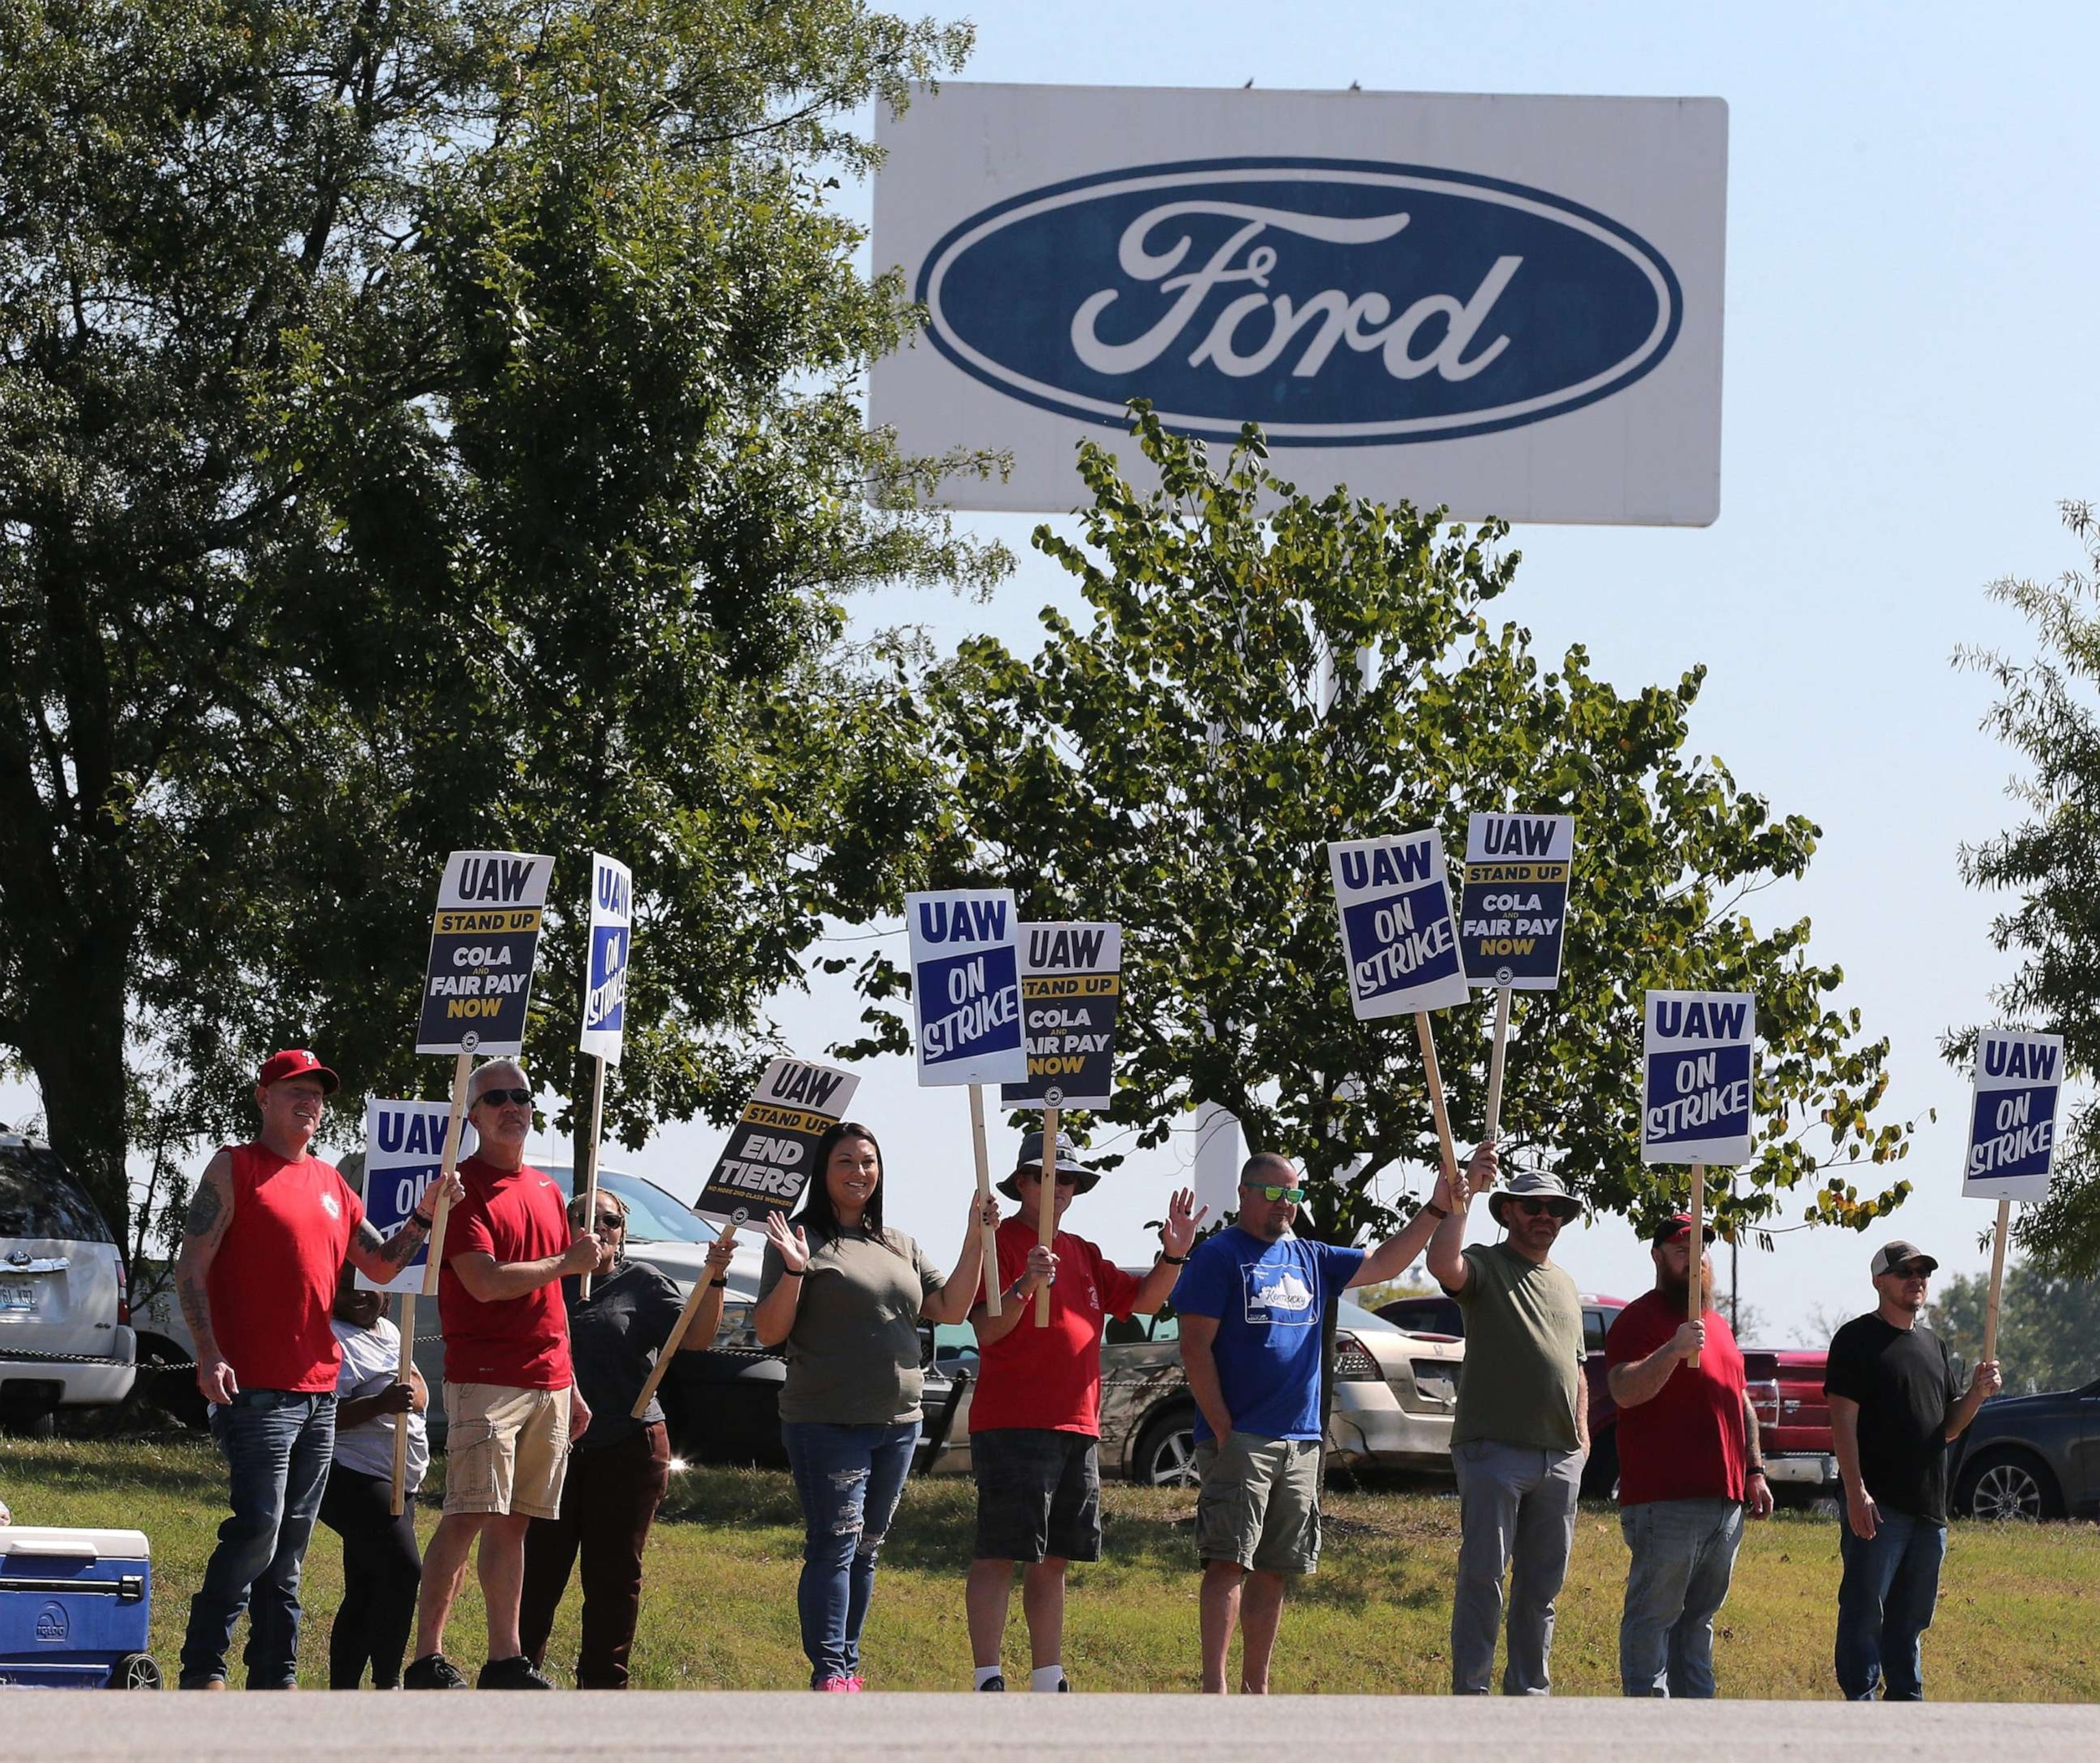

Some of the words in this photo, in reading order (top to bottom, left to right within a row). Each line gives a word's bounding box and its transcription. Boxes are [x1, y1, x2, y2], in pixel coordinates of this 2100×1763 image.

[1071, 200, 1524, 383] Ford
[1484, 819, 1557, 856] UAW
[459, 859, 535, 901] UAW
[1340, 840, 1431, 889] UAW
[1470, 868, 1531, 881] STAND
[1537, 867, 1562, 880] UP
[598, 865, 629, 920] UAW
[1483, 894, 1542, 911] COLA
[441, 915, 505, 930] STAND
[509, 914, 535, 928] UP
[919, 900, 1007, 943] UAW
[1375, 897, 1414, 943] ON
[1463, 919, 1511, 937] FAIR
[1515, 919, 1559, 936] PAY
[453, 945, 512, 967] COLA
[604, 931, 621, 976] ON
[1029, 930, 1105, 969] UAW
[1355, 917, 1453, 996] STRIKE
[1481, 939, 1535, 956] NOW
[430, 975, 481, 996] FAIR
[484, 973, 527, 995] PAY
[588, 967, 625, 1027] STRIKE
[948, 956, 984, 1005] ON
[1086, 979, 1112, 993] UP
[446, 997, 502, 1019] NOW
[924, 984, 1019, 1061] STRIKE
[1028, 1008, 1092, 1029] COLA
[1656, 1001, 1747, 1040] UAW
[1025, 1036, 1060, 1055] AIR
[1064, 1034, 1111, 1053] PAY
[1984, 1040, 2058, 1081] UAW
[771, 1063, 844, 1107] UAW
[1028, 1055, 1086, 1076] NOW
[1675, 1051, 1717, 1094] ON
[748, 1107, 801, 1127] STAND
[805, 1117, 831, 1132] UP
[1647, 1079, 1749, 1141] STRIKE
[1995, 1092, 2031, 1131] ON
[378, 1112, 468, 1155] UAW
[739, 1134, 805, 1166] END
[1969, 1119, 2053, 1176] STRIKE
[718, 1159, 805, 1197] TIERS
